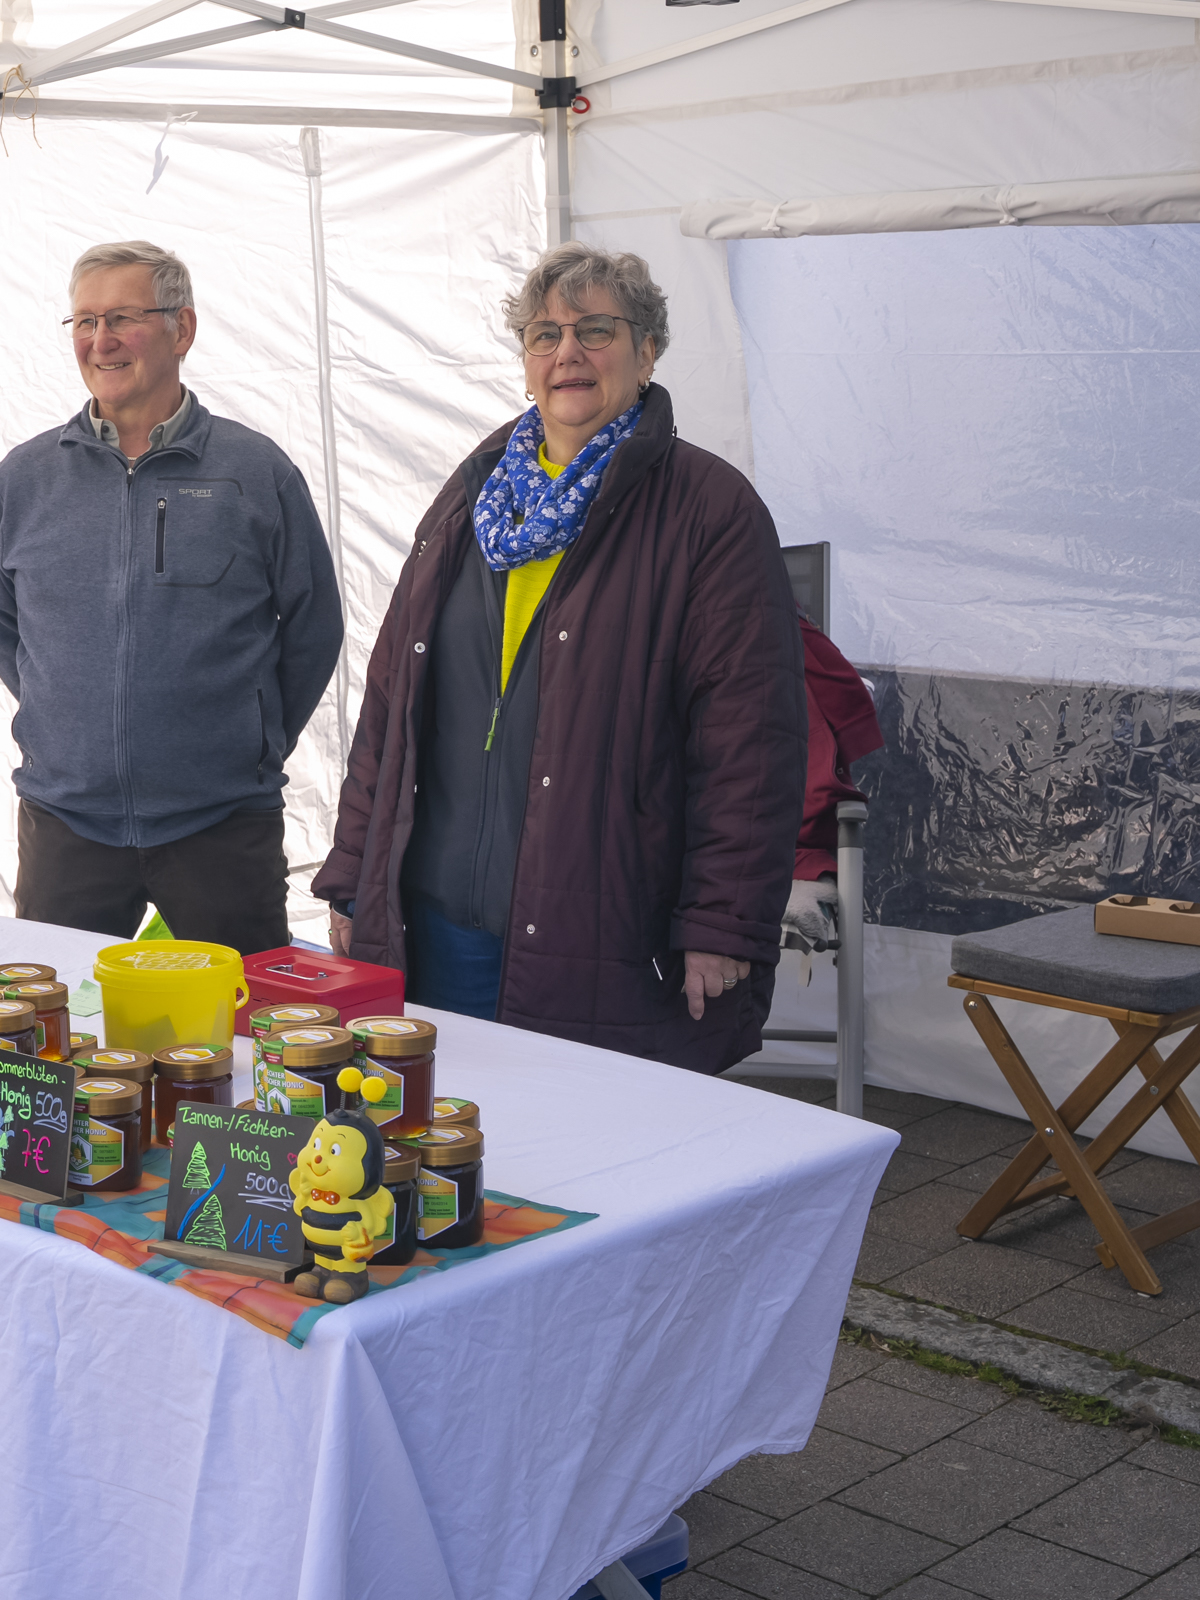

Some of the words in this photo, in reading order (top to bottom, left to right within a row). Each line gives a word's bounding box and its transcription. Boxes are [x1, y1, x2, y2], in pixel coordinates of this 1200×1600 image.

[267, 1070, 285, 1079] ECHTER
[282, 1080, 304, 1089] HONIG
[363, 1069, 384, 1077] HONIG
[1, 1081, 31, 1119] Honig
[34, 1091, 67, 1133] 500g
[230, 1142, 271, 1171] Honig
[245, 1172, 293, 1208] 500g
